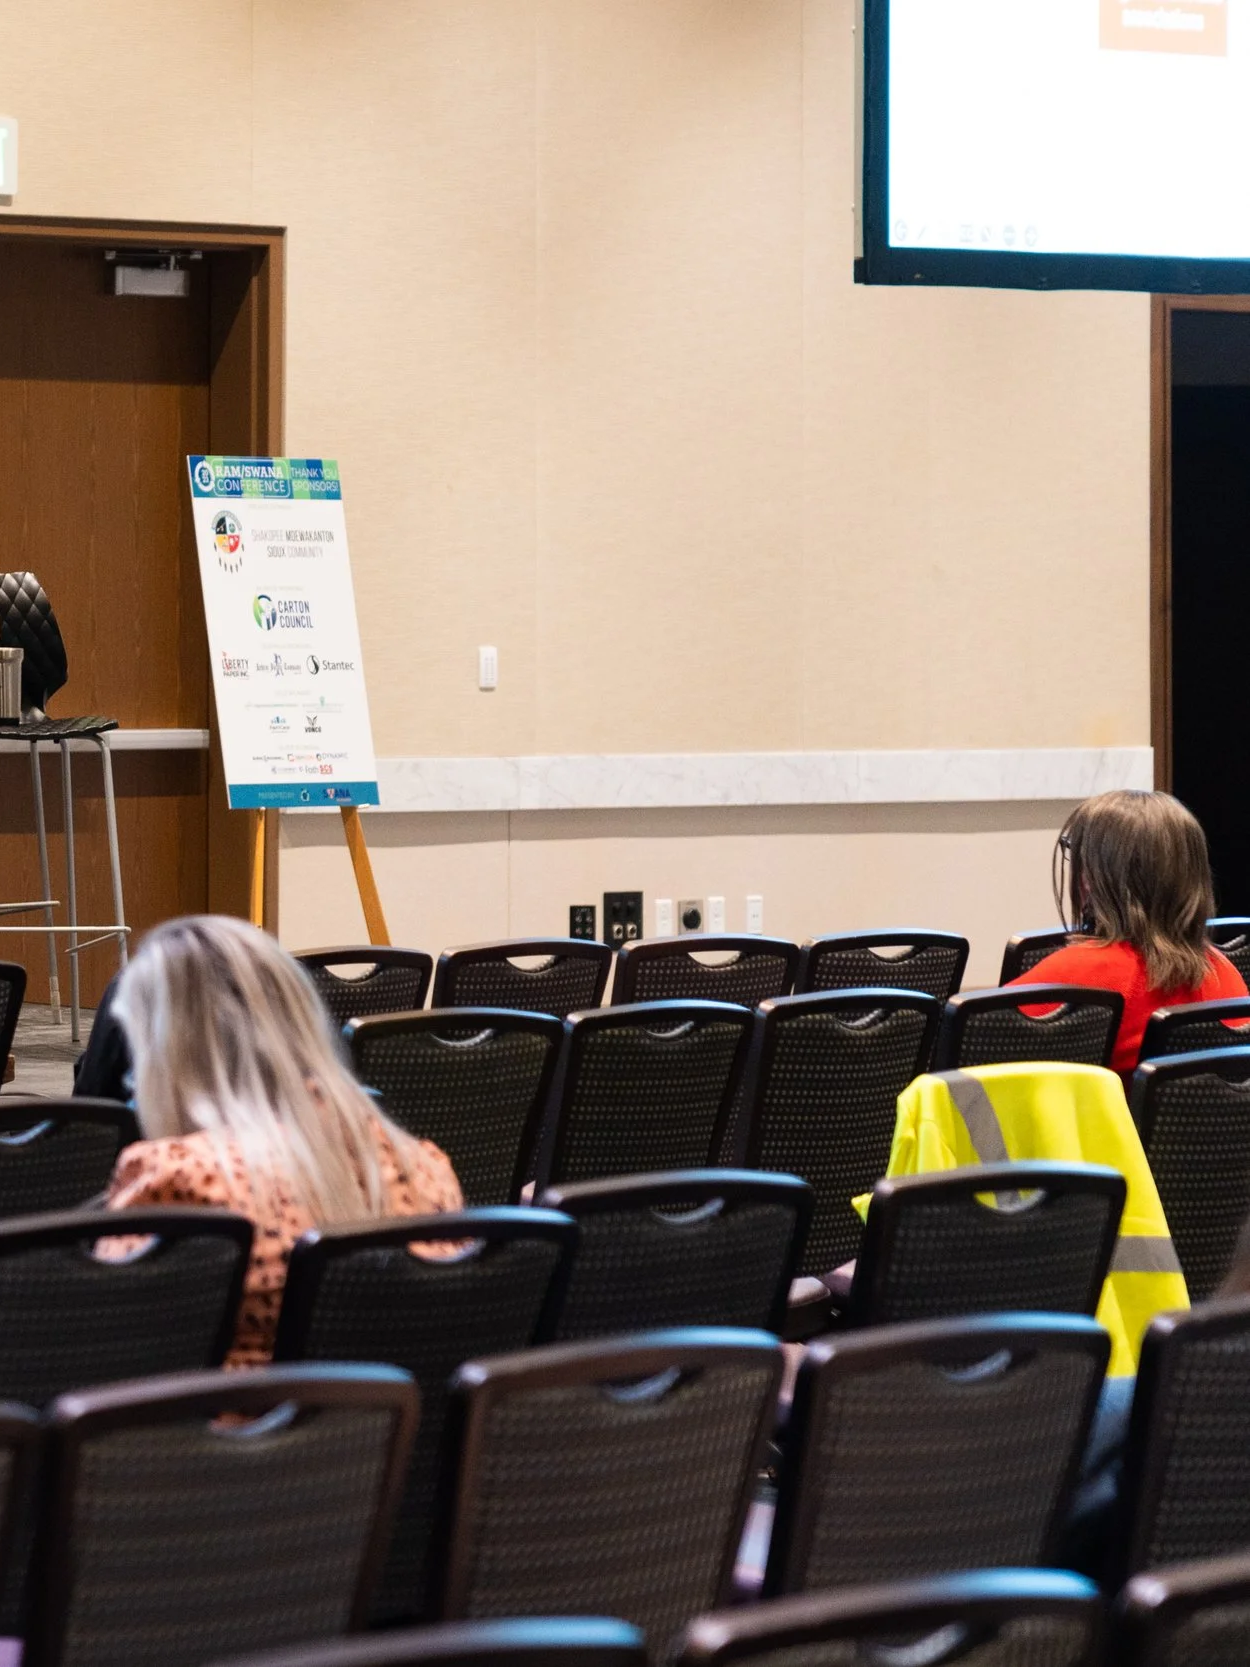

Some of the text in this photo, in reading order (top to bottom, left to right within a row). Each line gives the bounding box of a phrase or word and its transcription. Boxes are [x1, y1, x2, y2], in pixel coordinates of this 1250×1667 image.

[215, 464, 284, 479] RAM/SWANA
[291, 467, 338, 479] THANK YOU
[216, 479, 287, 493] CONFERENCE
[292, 480, 339, 492] SPONSORS!
[251, 529, 284, 542] SHAKOPEE
[267, 545, 324, 558] SIOUX COMMUNITY
[277, 600, 310, 614] CARTON
[279, 615, 314, 629] COUNCIL
[221, 658, 249, 670] LIBERTY
[322, 660, 354, 671] Stantec
